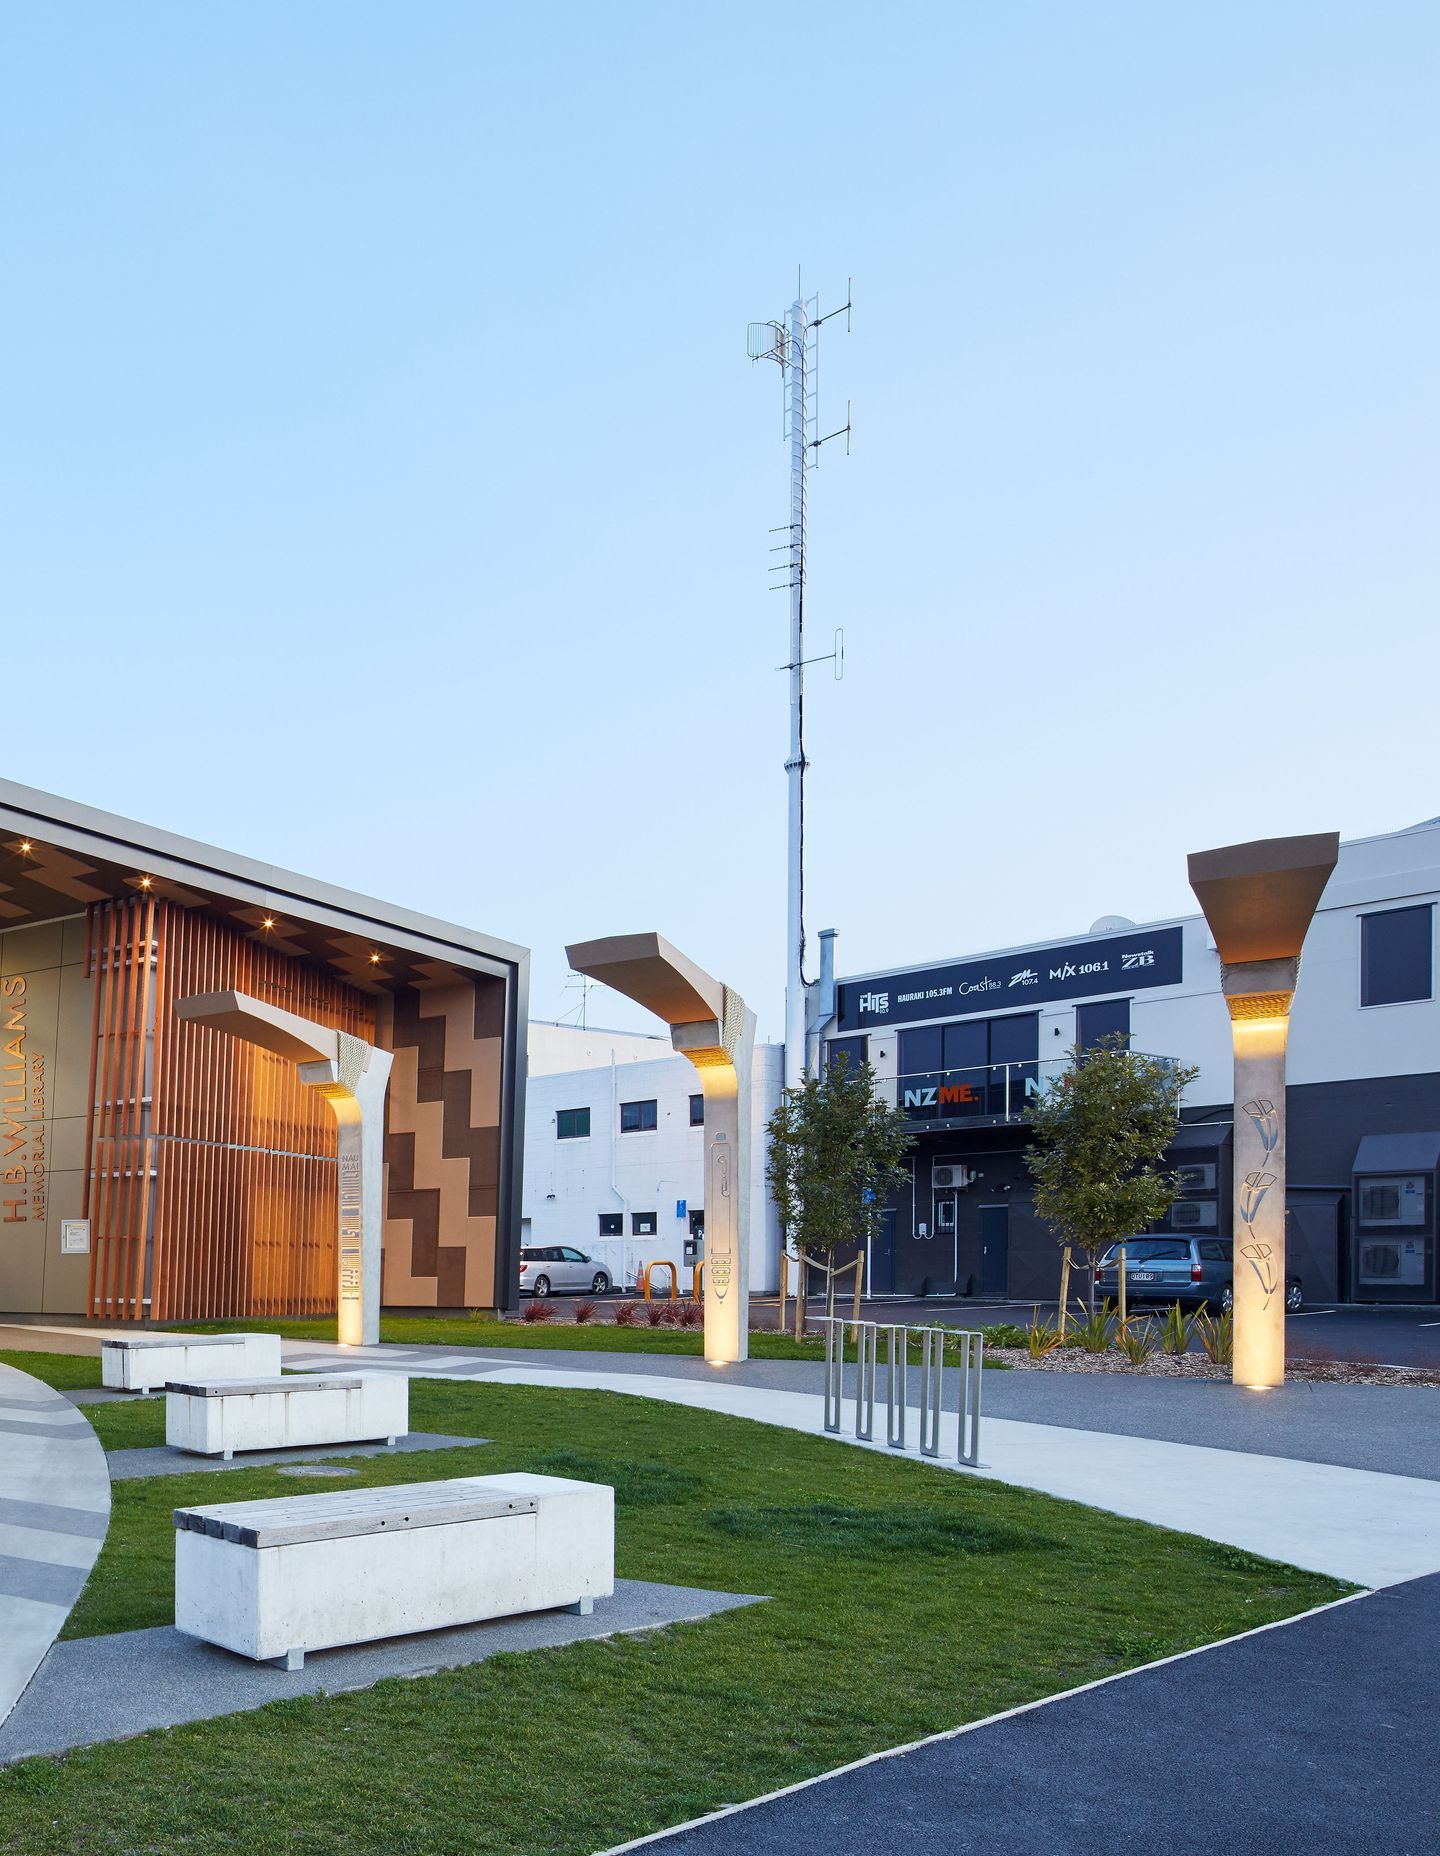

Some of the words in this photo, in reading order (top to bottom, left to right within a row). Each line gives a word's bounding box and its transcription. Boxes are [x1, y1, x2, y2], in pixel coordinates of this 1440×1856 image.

[1078, 961, 1109, 975] 106.1
[1121, 955, 1155, 969] ZB
[958, 976, 993, 995] Coast
[1008, 969, 1038, 987] ZM
[1021, 978, 1039, 986] 107.4
[897, 991, 925, 1003] HAURAKI
[925, 987, 953, 999] 105.3FM
[31, 1051, 45, 1119] LIBRARY
[342, 1154, 358, 1162] NAU
[32, 1125, 45, 1221] MEMORIAL
